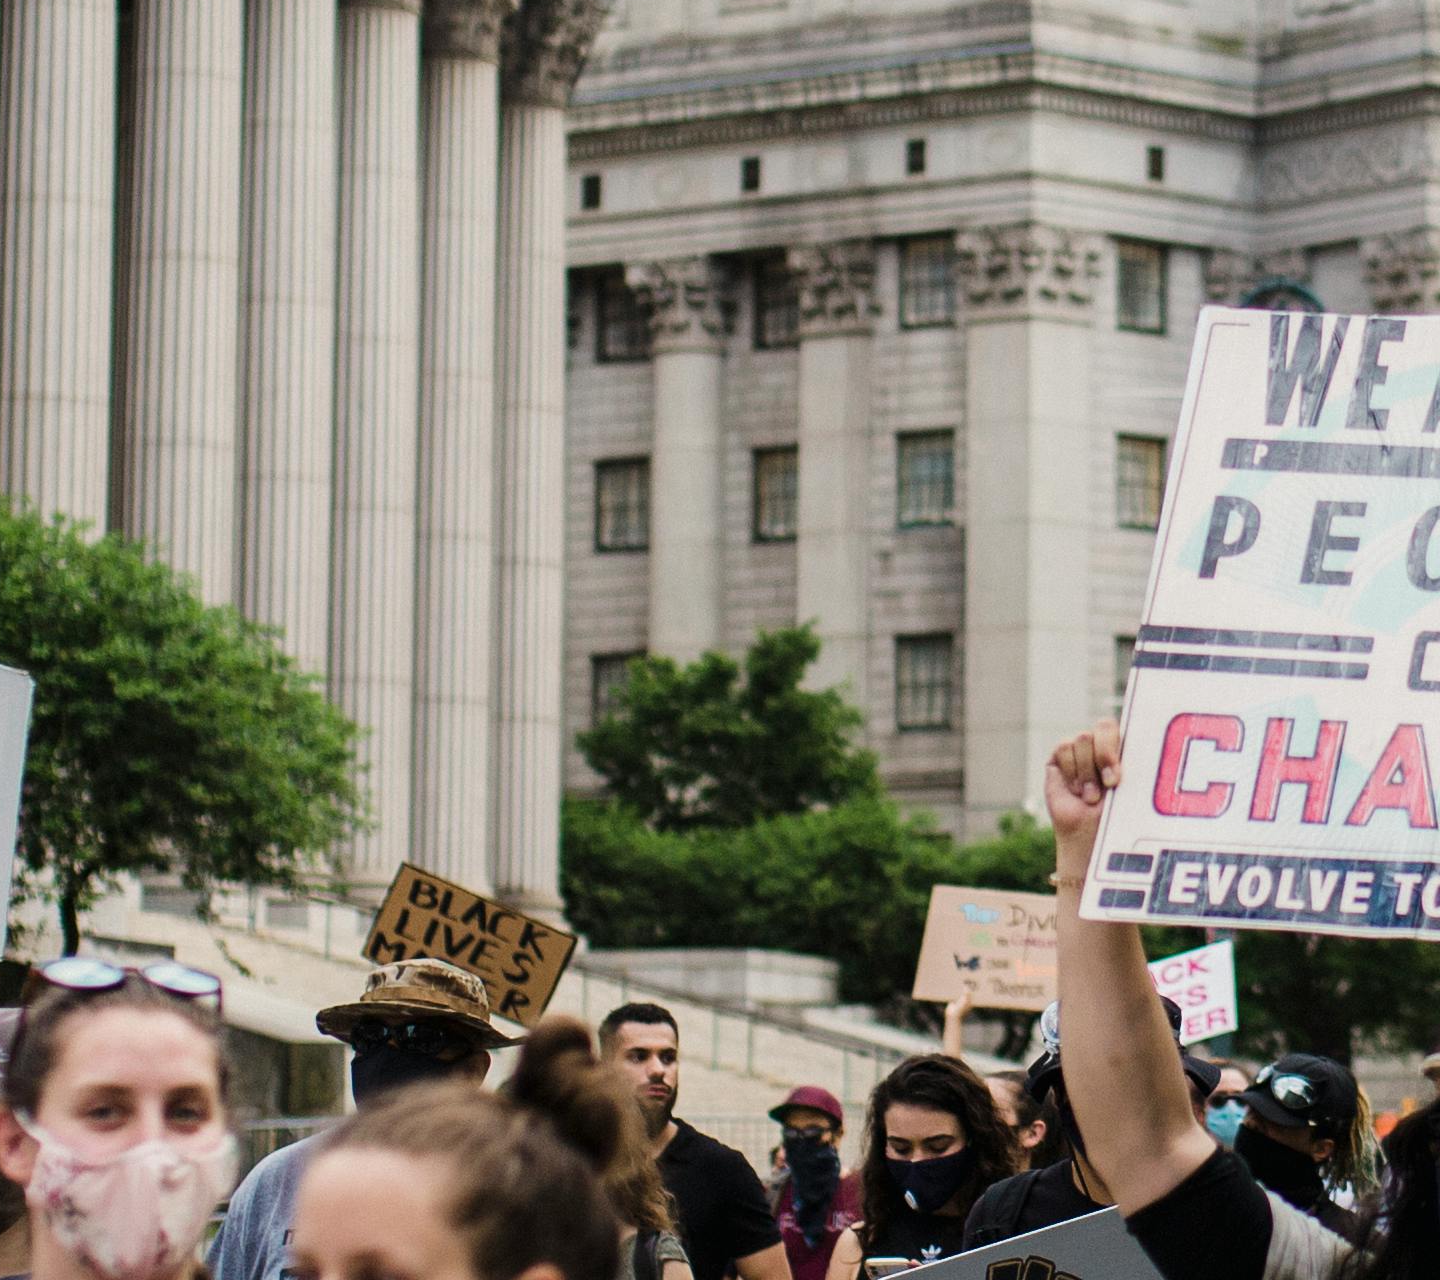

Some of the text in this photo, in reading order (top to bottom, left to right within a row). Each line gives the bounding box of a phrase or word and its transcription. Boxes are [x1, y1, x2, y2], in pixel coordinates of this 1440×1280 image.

[1263, 313, 1406, 428] WE
[408, 879, 550, 961] BLACK
[1166, 860, 1378, 910] EVOLVE
[394, 908, 536, 985] LIVES
